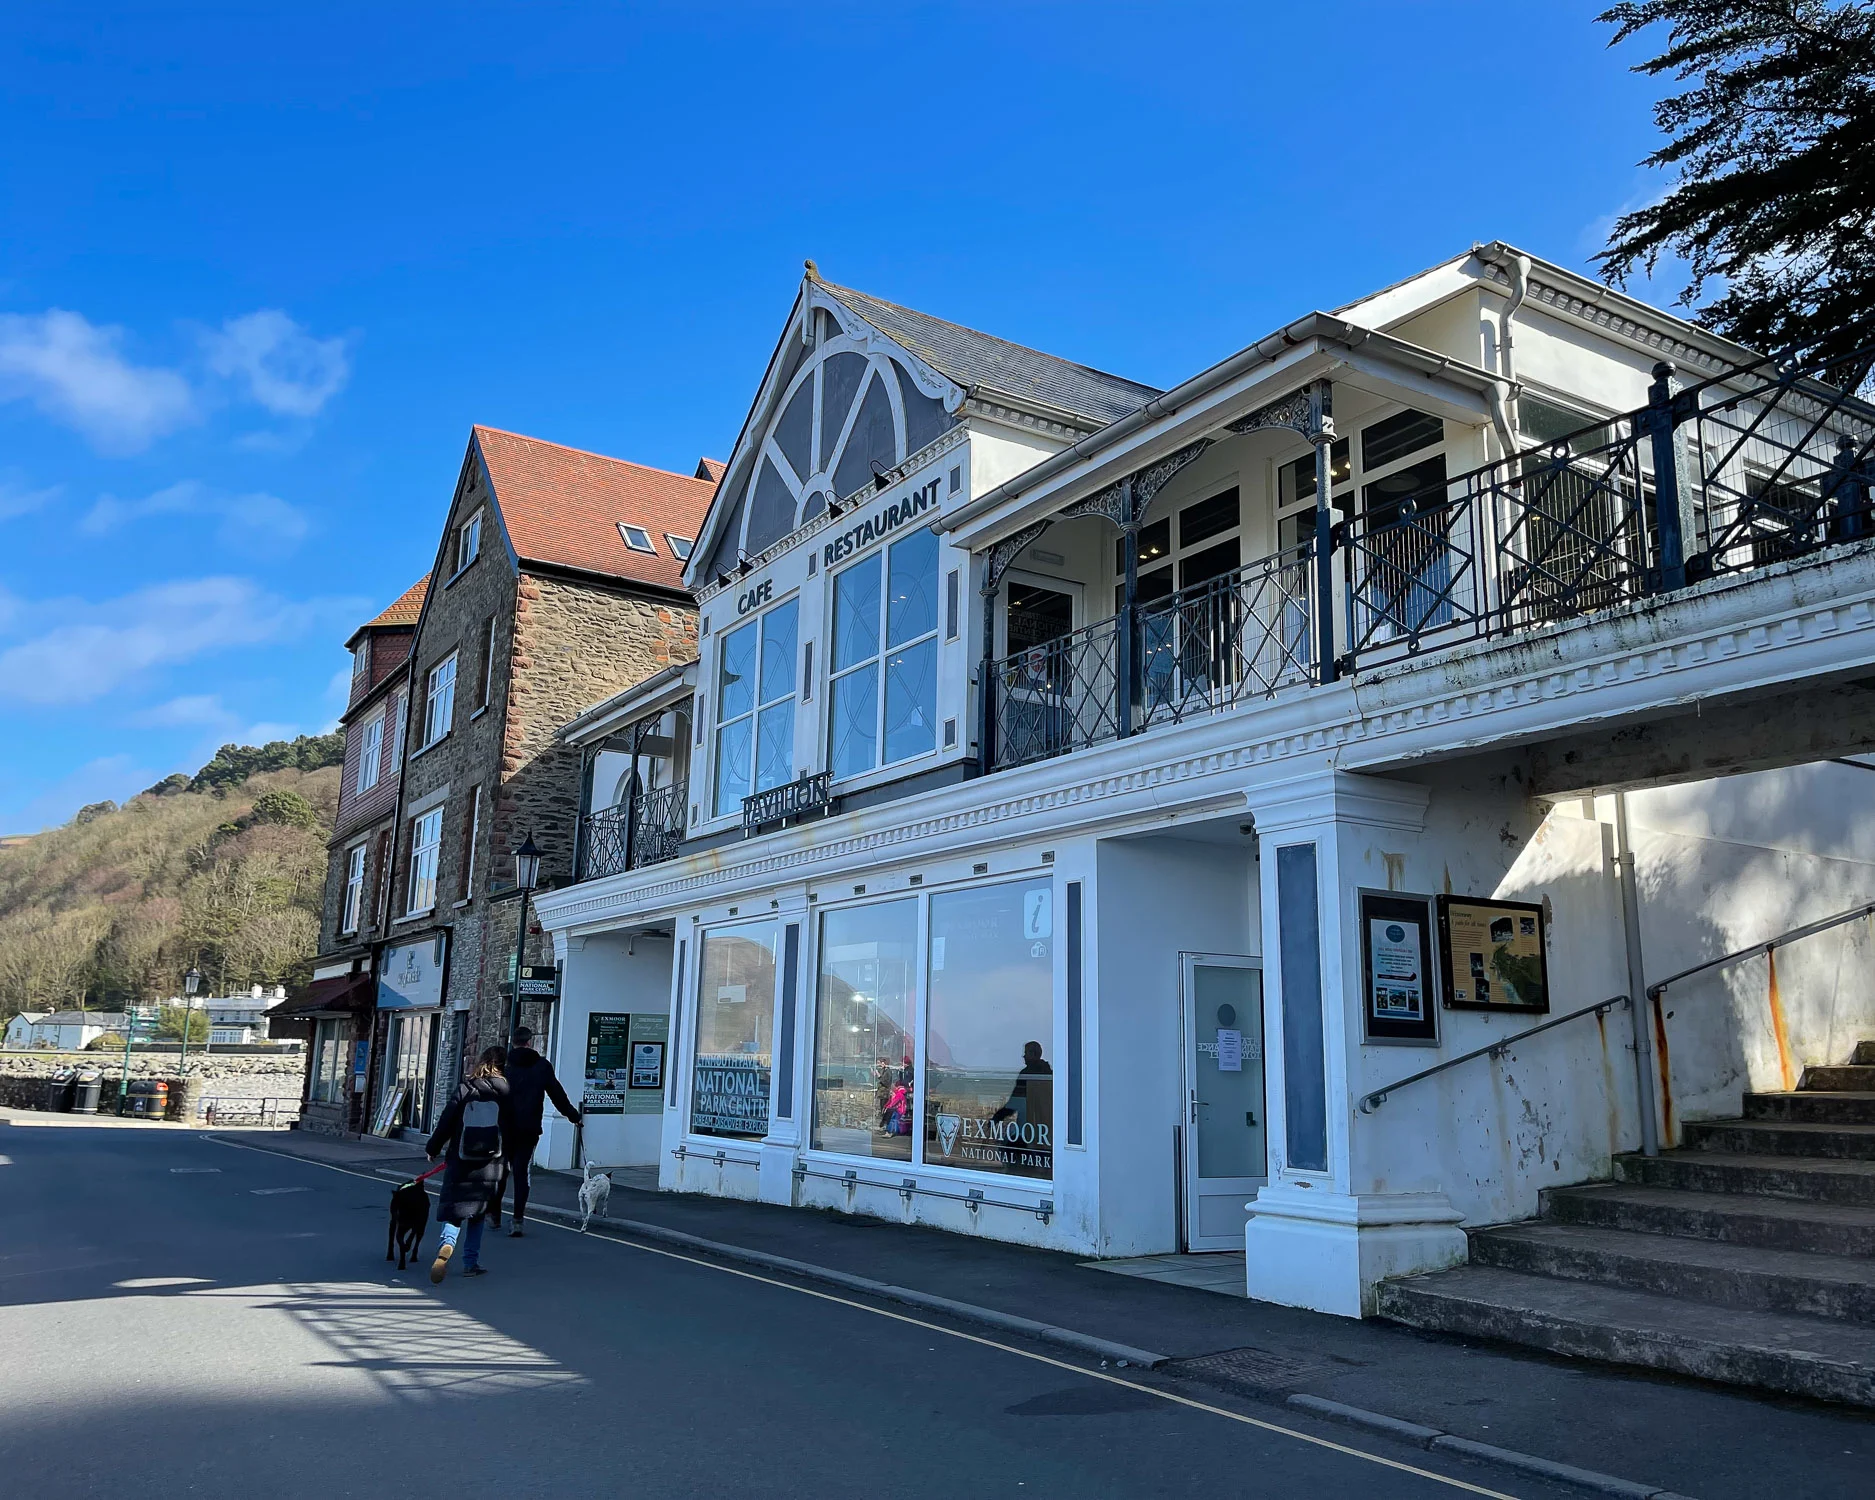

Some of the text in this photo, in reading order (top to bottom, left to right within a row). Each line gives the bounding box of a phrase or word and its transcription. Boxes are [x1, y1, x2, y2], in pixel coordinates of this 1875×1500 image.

[738, 477, 941, 615] CAFE RESTAURANT
[743, 774, 829, 827] PAVILION
[697, 1054, 737, 1068] LYNMOUTH
[696, 1071, 764, 1096] NATIONAL
[701, 1095, 727, 1113] PARK
[961, 1117, 1051, 1146] EXMOOR
[961, 1147, 1051, 1169] NATIONAL PARK
